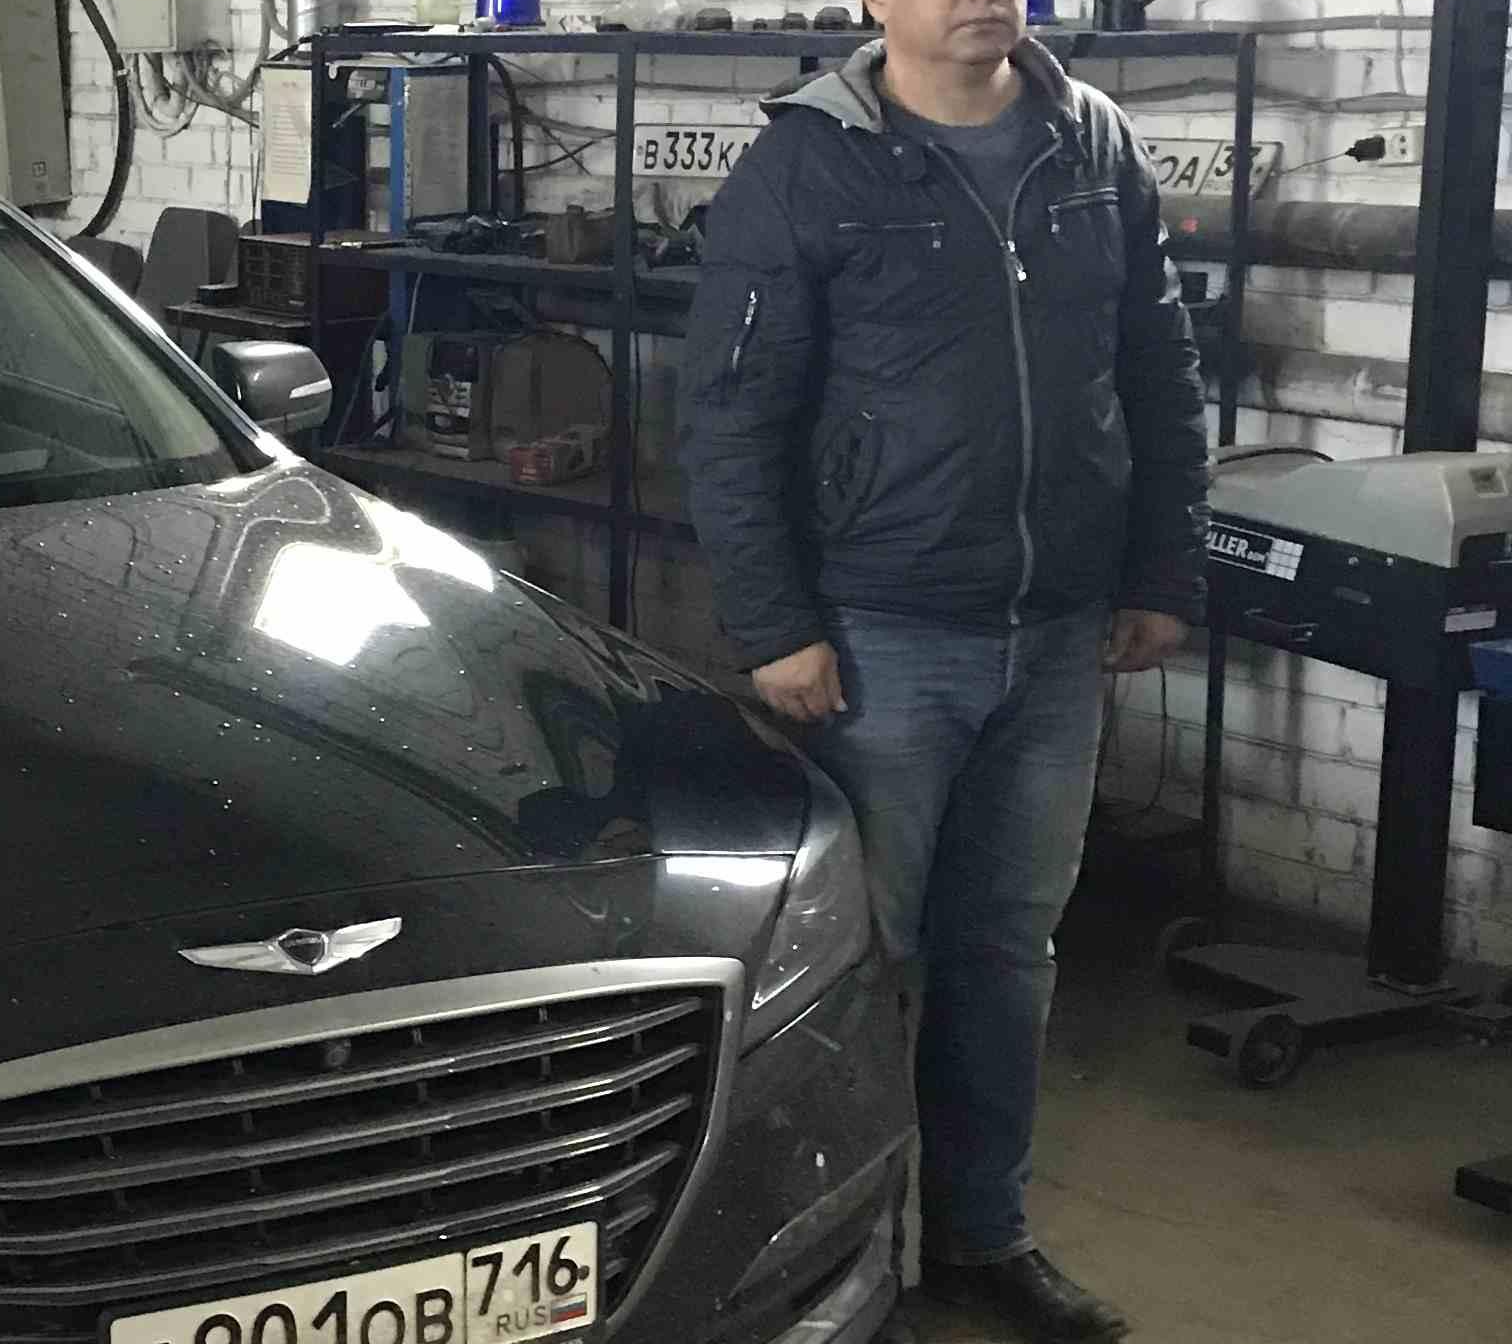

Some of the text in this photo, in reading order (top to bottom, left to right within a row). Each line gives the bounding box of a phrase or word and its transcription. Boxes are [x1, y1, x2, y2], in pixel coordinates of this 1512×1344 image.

[1205, 530, 1248, 558] LLER
[472, 1236, 579, 1316] 716
[496, 1305, 546, 1336] RUS
